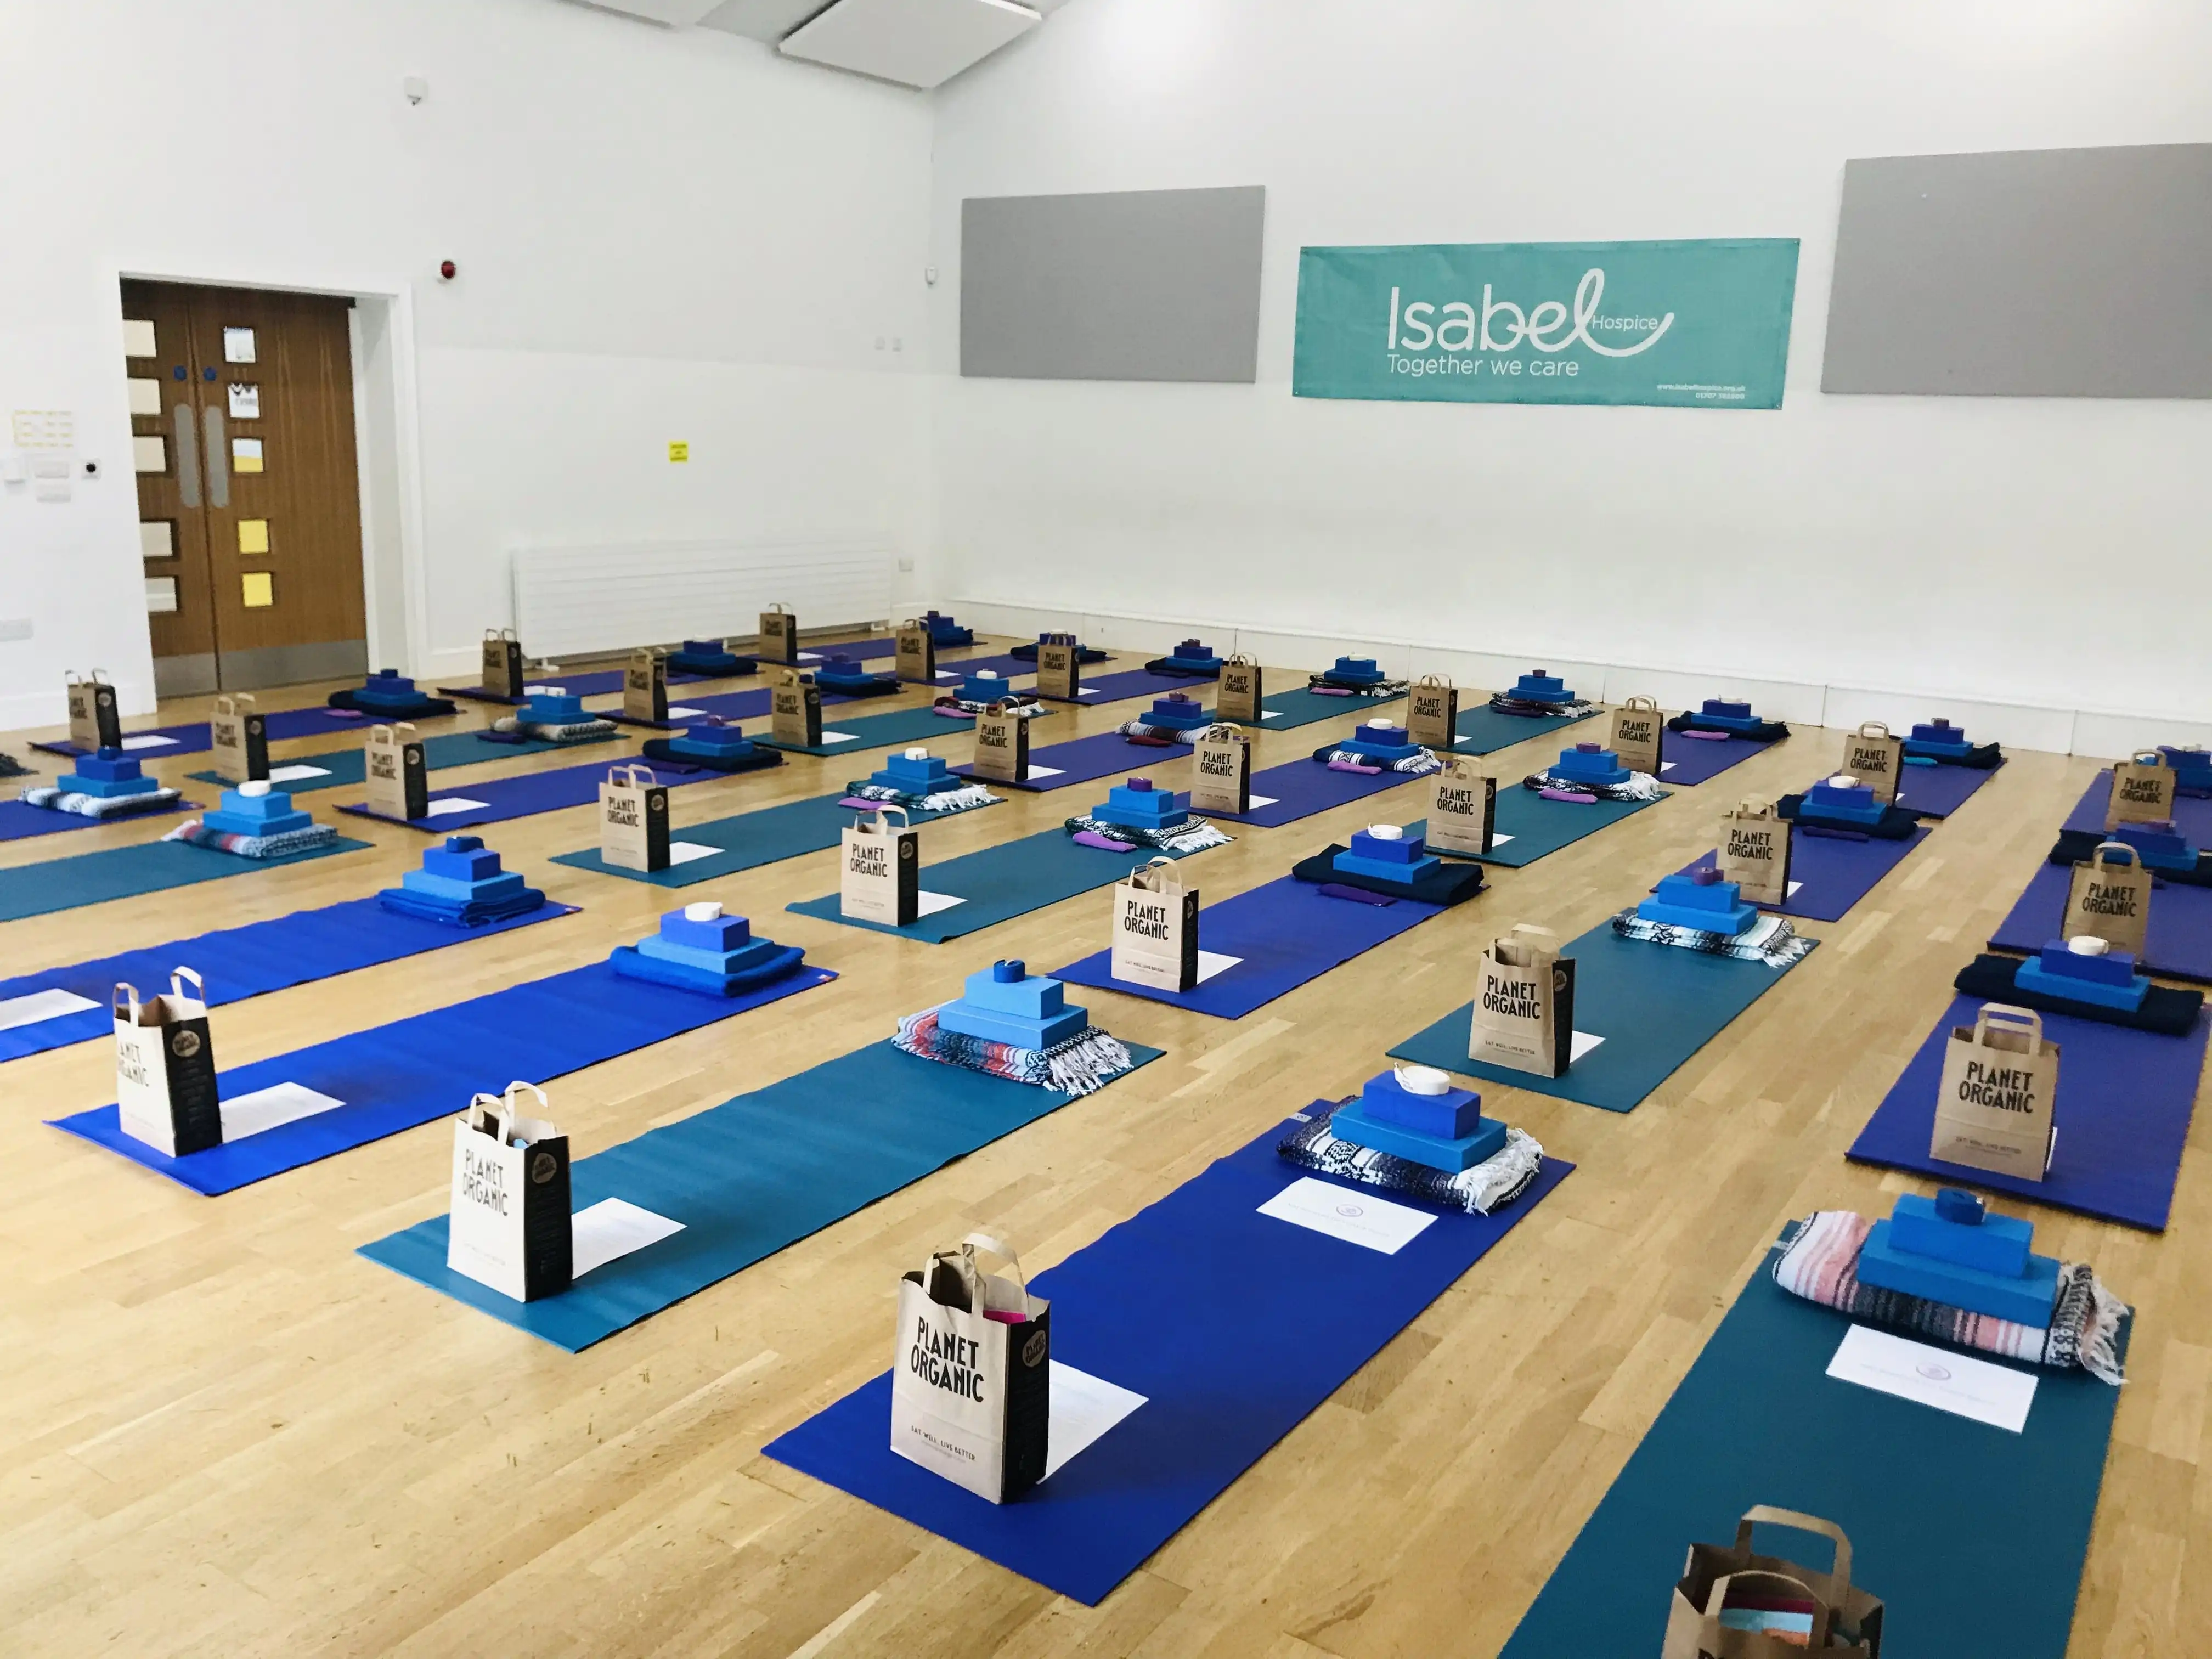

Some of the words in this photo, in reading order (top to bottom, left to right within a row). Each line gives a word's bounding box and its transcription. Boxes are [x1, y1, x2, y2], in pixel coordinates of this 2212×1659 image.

[1386, 267, 1674, 358] Isabel
[1592, 314, 1658, 332] Hospice
[1387, 353, 1484, 378] Together
[1490, 360, 1522, 375] we
[1528, 360, 1579, 376] care
[1043, 661, 1066, 671] ORGANIC
[1045, 652, 1065, 662] PLANET
[1224, 681, 1249, 694] ORGANIC
[1227, 674, 1248, 685] PLANET
[1417, 696, 1440, 708] PLANET
[1414, 706, 1441, 718] ORGANIC
[981, 724, 1006, 737] PLANET
[1621, 719, 1650, 732] PLANET
[979, 734, 1008, 748] ORGANIC
[1618, 729, 1651, 743] ORGANIC
[1203, 750, 1232, 765] PLANET
[1854, 747, 1887, 761] PLANET
[1200, 763, 1234, 777] ORGANIC
[1850, 759, 1888, 772] ORGANIC
[2124, 777, 2162, 792] PLANET
[1440, 786, 1472, 802] PLANET
[1436, 798, 1475, 816] ORGANIC
[1731, 829, 1771, 846] PLANET
[852, 843, 885, 862] PLANET
[1727, 842, 1773, 861] ORGANIC
[850, 857, 888, 878] ORGANIC
[2087, 882, 2137, 901] PLANET
[1127, 899, 1166, 923] PLANET
[2081, 896, 2137, 918] ORGANIC
[1124, 916, 1169, 941] ORGANIC
[1487, 974, 1537, 1001] PLANET
[1483, 992, 1542, 1020] ORGANIC
[1966, 1060, 2034, 1092] PLANET
[1958, 1084, 2036, 1114] ORGANIC
[465, 1148, 504, 1189] PLANET
[462, 1176, 509, 1217] ORGANIC
[918, 1316, 979, 1370] PLANET
[910, 1344, 985, 1403] ORGANIC
[911, 1425, 922, 1436] EAT
